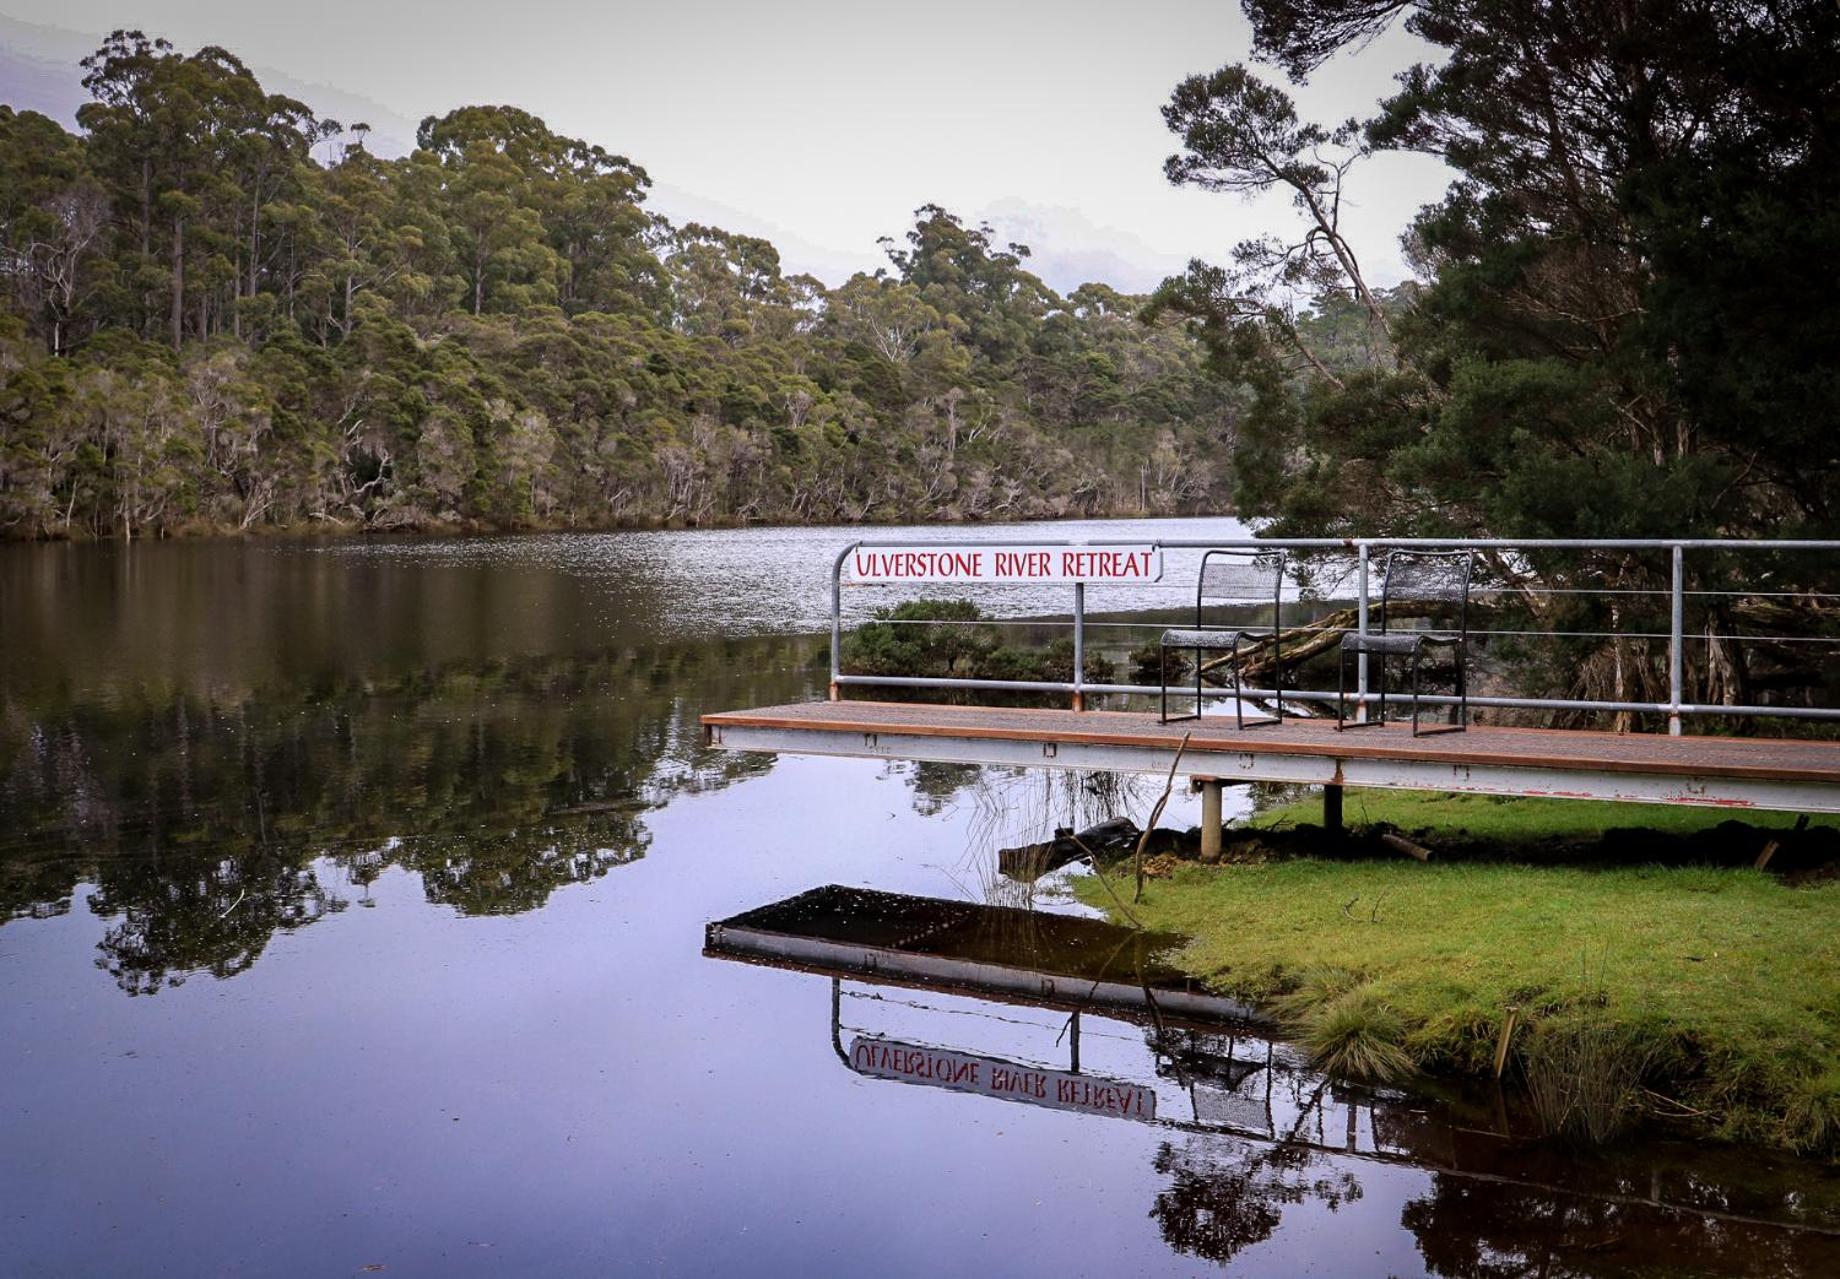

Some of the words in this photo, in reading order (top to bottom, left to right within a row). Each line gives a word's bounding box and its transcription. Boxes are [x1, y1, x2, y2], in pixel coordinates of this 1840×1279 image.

[856, 552, 982, 577] ULVERSTONE
[994, 552, 1051, 577] RIVER
[1061, 552, 1152, 577] RETREAT
